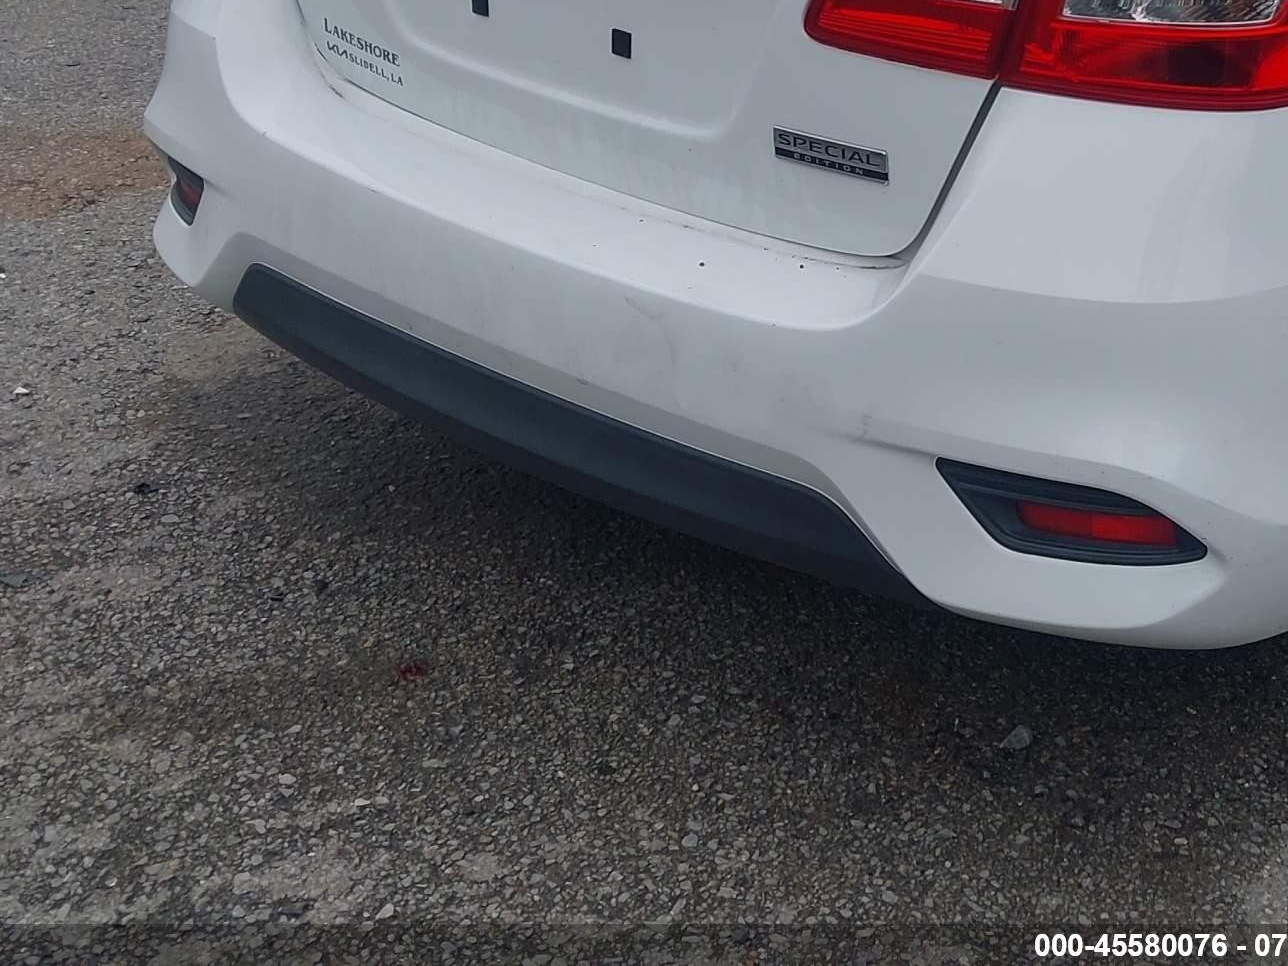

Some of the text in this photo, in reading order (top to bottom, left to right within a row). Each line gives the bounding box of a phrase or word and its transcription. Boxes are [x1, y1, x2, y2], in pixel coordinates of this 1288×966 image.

[324, 18, 400, 66] LAKESHORE
[391, 73, 403, 86] LA
[778, 133, 881, 167] SPECIAL
[793, 153, 864, 175] EDITION
